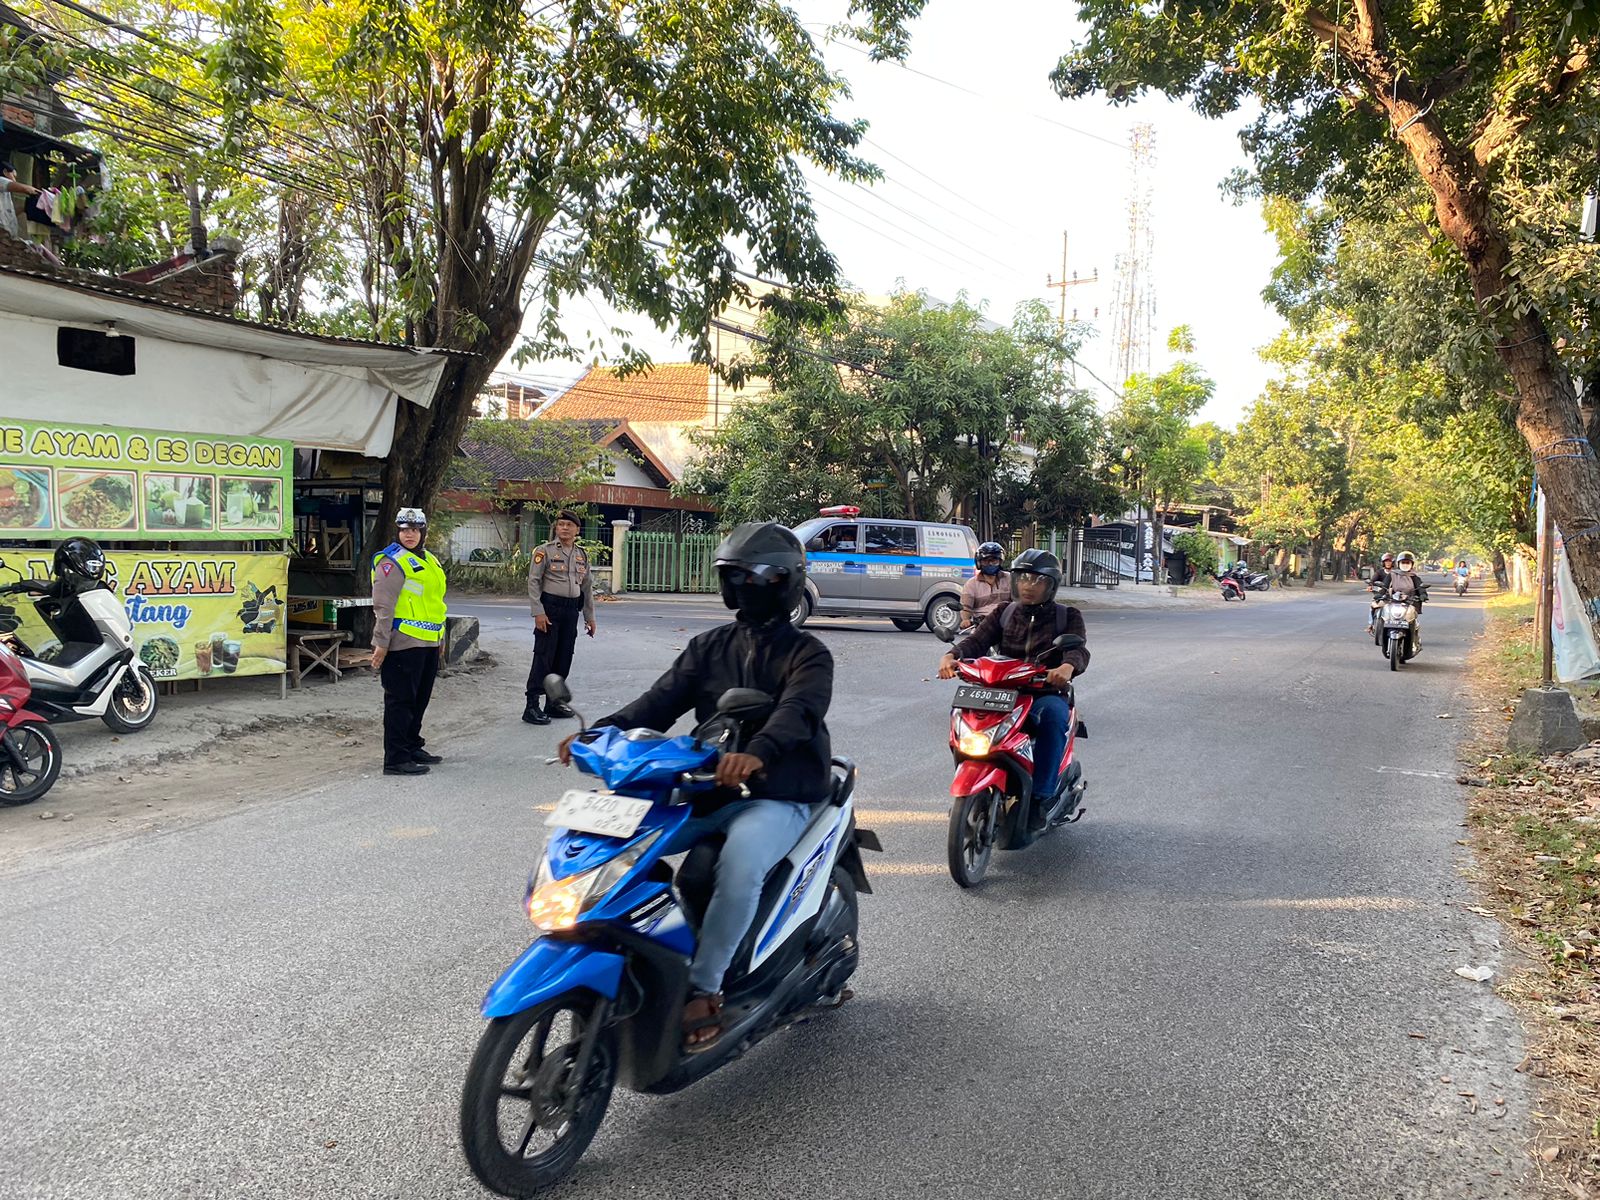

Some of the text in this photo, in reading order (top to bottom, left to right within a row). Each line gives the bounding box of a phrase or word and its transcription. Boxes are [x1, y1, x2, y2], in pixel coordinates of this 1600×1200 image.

[31, 429, 120, 459] AYAM
[127, 437, 150, 461] &
[156, 439, 189, 463] ES
[194, 443, 282, 469] DEGAN
[124, 561, 236, 596] AYAM
[125, 595, 192, 631] tang
[149, 668, 177, 677] EKER
[958, 689, 1012, 702] S 4630 JBL
